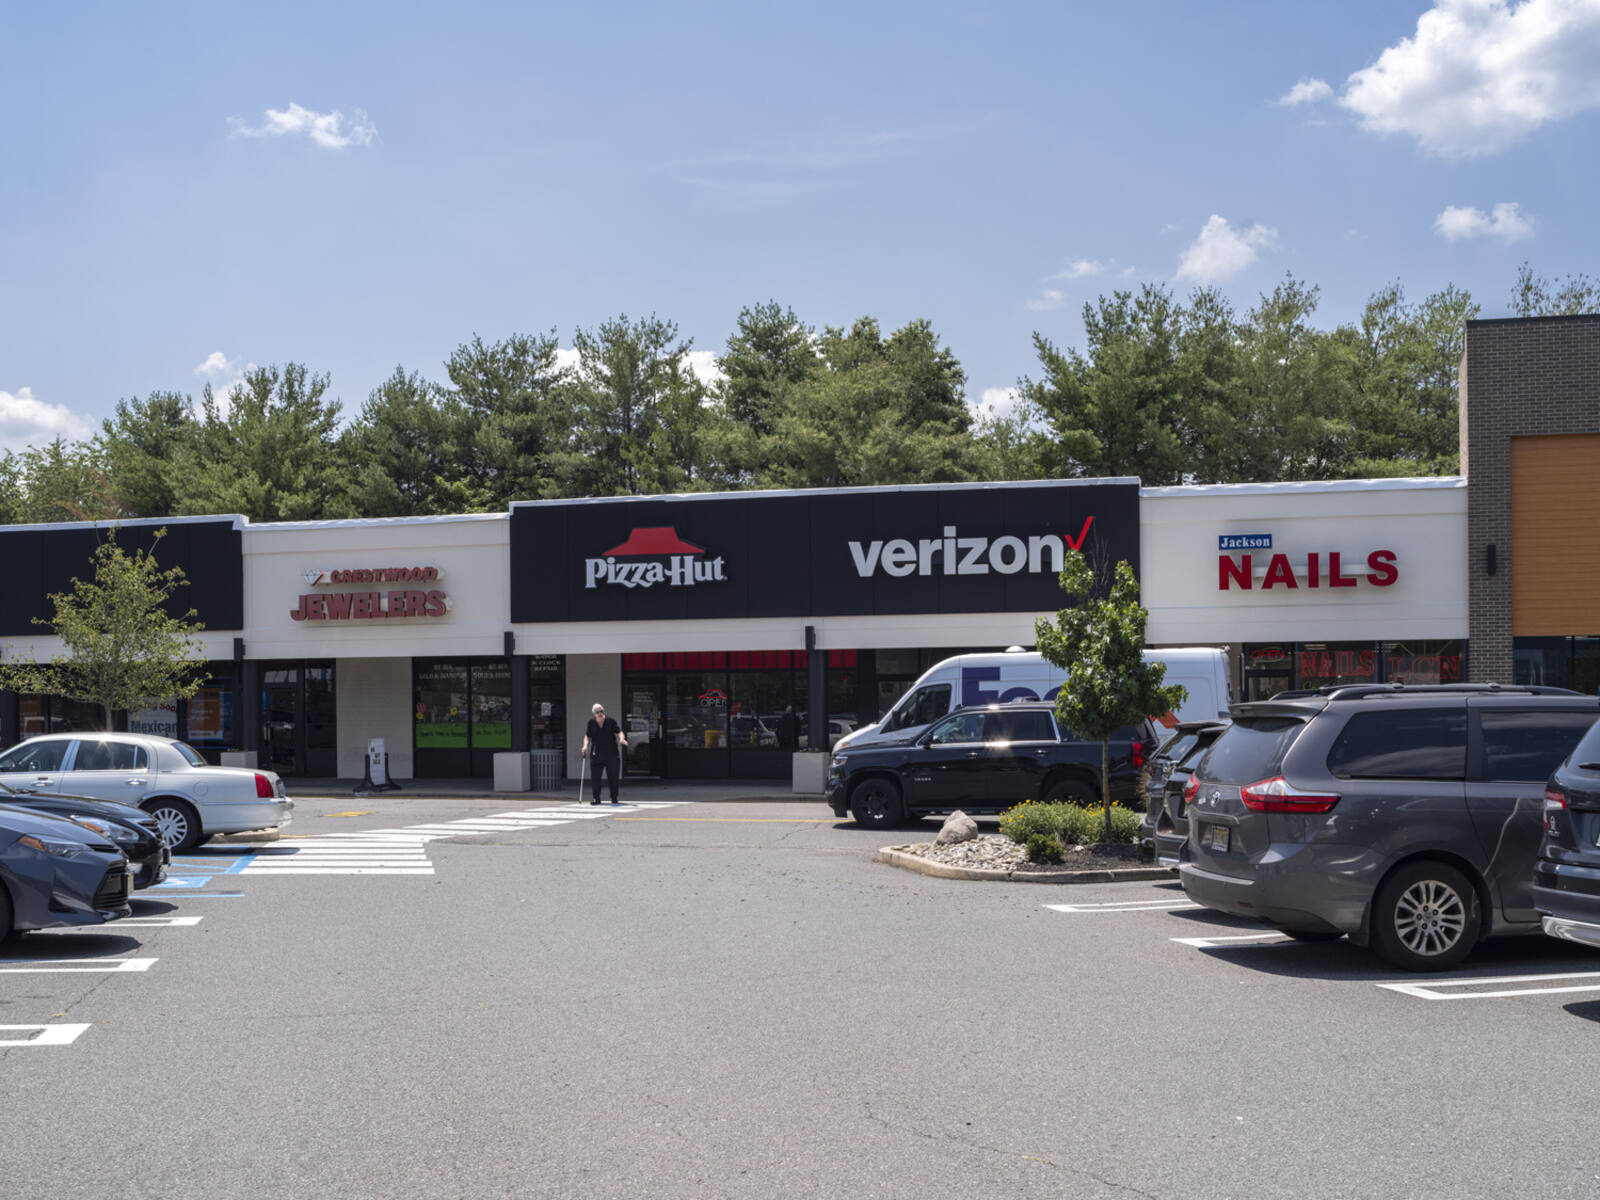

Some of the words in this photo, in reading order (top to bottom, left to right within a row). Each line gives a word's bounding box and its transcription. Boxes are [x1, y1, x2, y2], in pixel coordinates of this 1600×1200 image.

[848, 525, 1064, 577] verizon
[1220, 536, 1270, 548] Jackson
[330, 566, 438, 584] CRESTWOOD
[585, 556, 665, 588] Pizza
[665, 555, 725, 586] Hut
[1218, 549, 1399, 590] NAILS
[289, 590, 447, 621] JEWELERS
[1250, 649, 1285, 661] OPEN
[1300, 650, 1375, 678] NAILS
